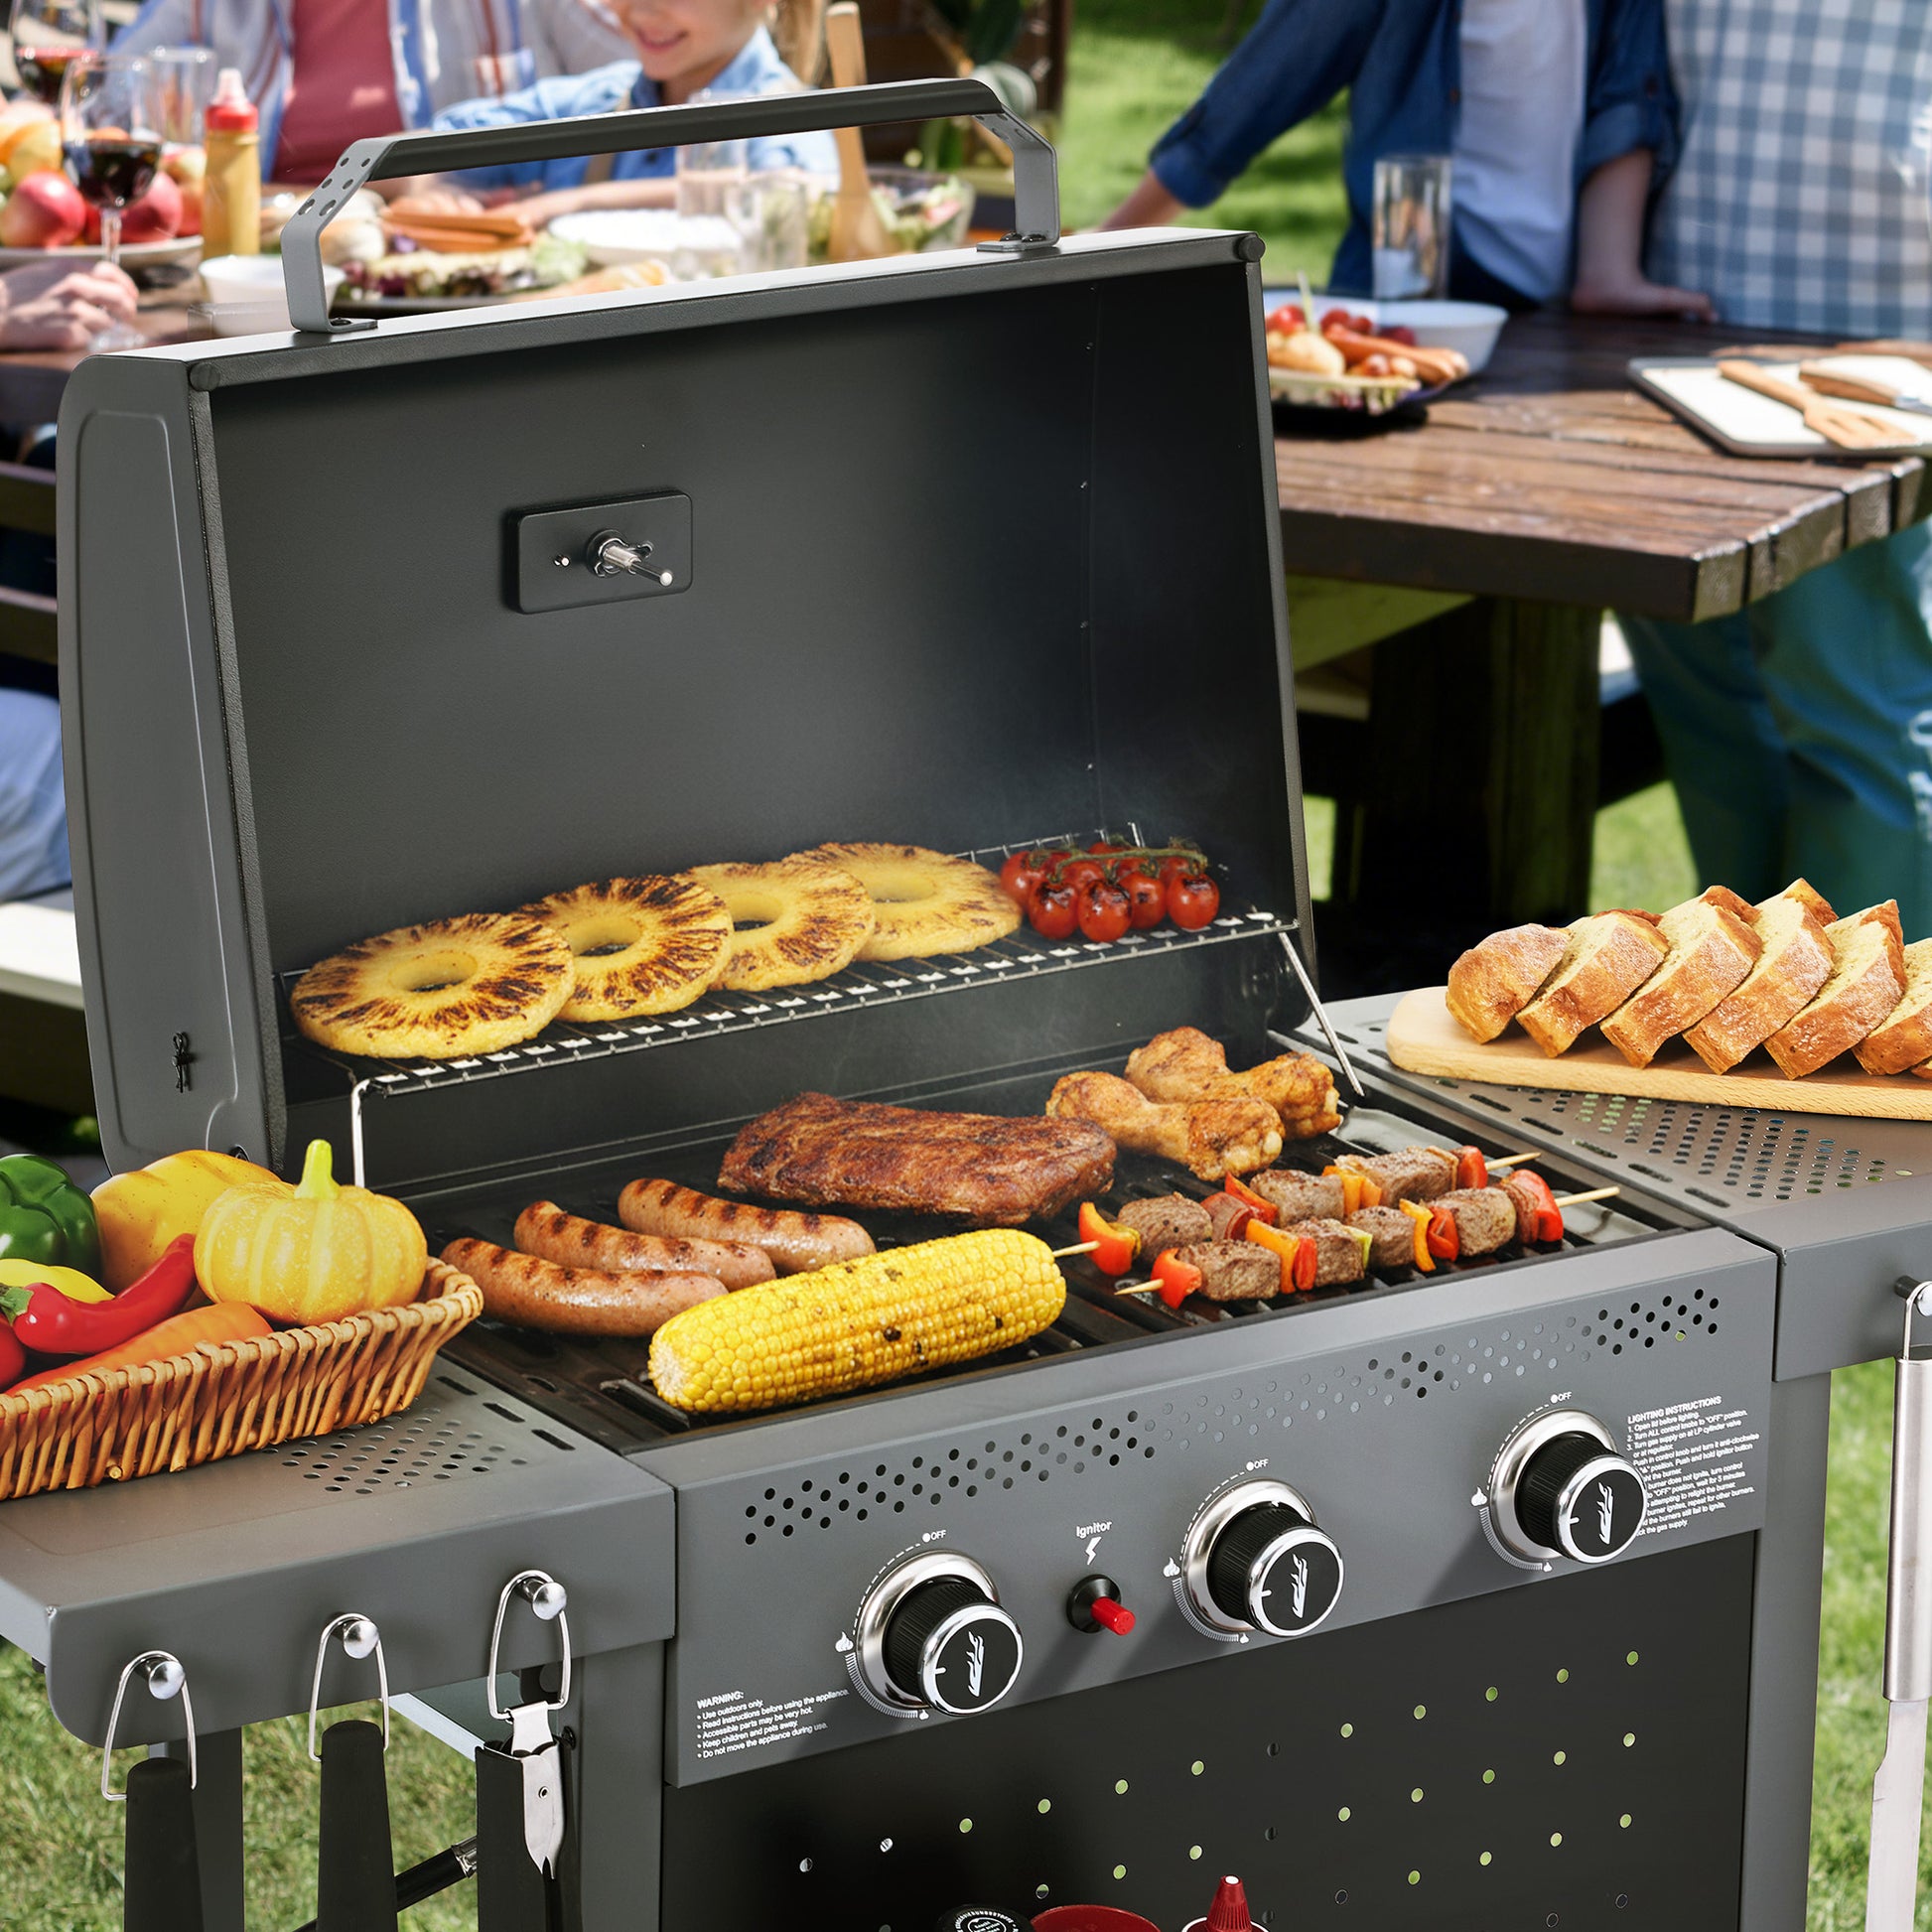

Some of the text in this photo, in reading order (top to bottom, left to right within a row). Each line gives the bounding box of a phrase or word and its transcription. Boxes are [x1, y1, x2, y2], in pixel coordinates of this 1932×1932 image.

[1559, 1392, 1572, 1401] OFF
[1628, 1395, 1722, 1424] LIGHTING INSTRUCTIONS
[1634, 1423, 1650, 1433] Open
[1659, 1416, 1678, 1426] before
[1660, 1423, 1680, 1435] control
[1659, 1434, 1678, 1444] supply
[1694, 1427, 1703, 1436] LP
[1703, 1423, 1725, 1434] cylinder
[1655, 1450, 1675, 1461] control
[1675, 1448, 1690, 1457] knob
[1690, 1445, 1702, 1453] and
[1675, 1456, 1691, 1465] Push
[1691, 1453, 1703, 1462] and
[1702, 1450, 1716, 1459] hold
[1733, 1443, 1753, 1452] button
[1255, 1459, 1269, 1469] OFF
[1648, 1480, 1668, 1490] burner
[1723, 1461, 1743, 1472] control
[1696, 1478, 1709, 1487] wait
[1723, 1470, 1745, 1481] minutes
[1650, 1494, 1681, 1507] attempting
[1688, 1496, 1707, 1507] repeat
[1715, 1491, 1731, 1500] other
[1659, 1512, 1682, 1522] burners
[931, 1530, 946, 1540] OFF
[1076, 1520, 1112, 1539] Ignitor
[1657, 1524, 1668, 1533] gas
[696, 1690, 745, 1710] WARNING:
[702, 1712, 717, 1721] Use
[717, 1704, 747, 1717] outdoors
[702, 1720, 722, 1729] Read
[760, 1705, 783, 1716] before
[783, 1700, 803, 1710] using
[702, 1725, 740, 1738] Accessible
[740, 1720, 758, 1731] parts
[759, 1716, 773, 1725] may
[784, 1710, 799, 1719] very
[702, 1737, 721, 1749] Keep
[722, 1730, 749, 1743] children
[750, 1726, 762, 1736] and
[763, 1723, 778, 1734] pets
[703, 1750, 714, 1759] Do
[715, 1746, 727, 1755] not
[727, 1743, 745, 1753] move
[747, 1739, 758, 1748] the
[758, 1731, 791, 1745] appliance
[791, 1725, 813, 1736] during
